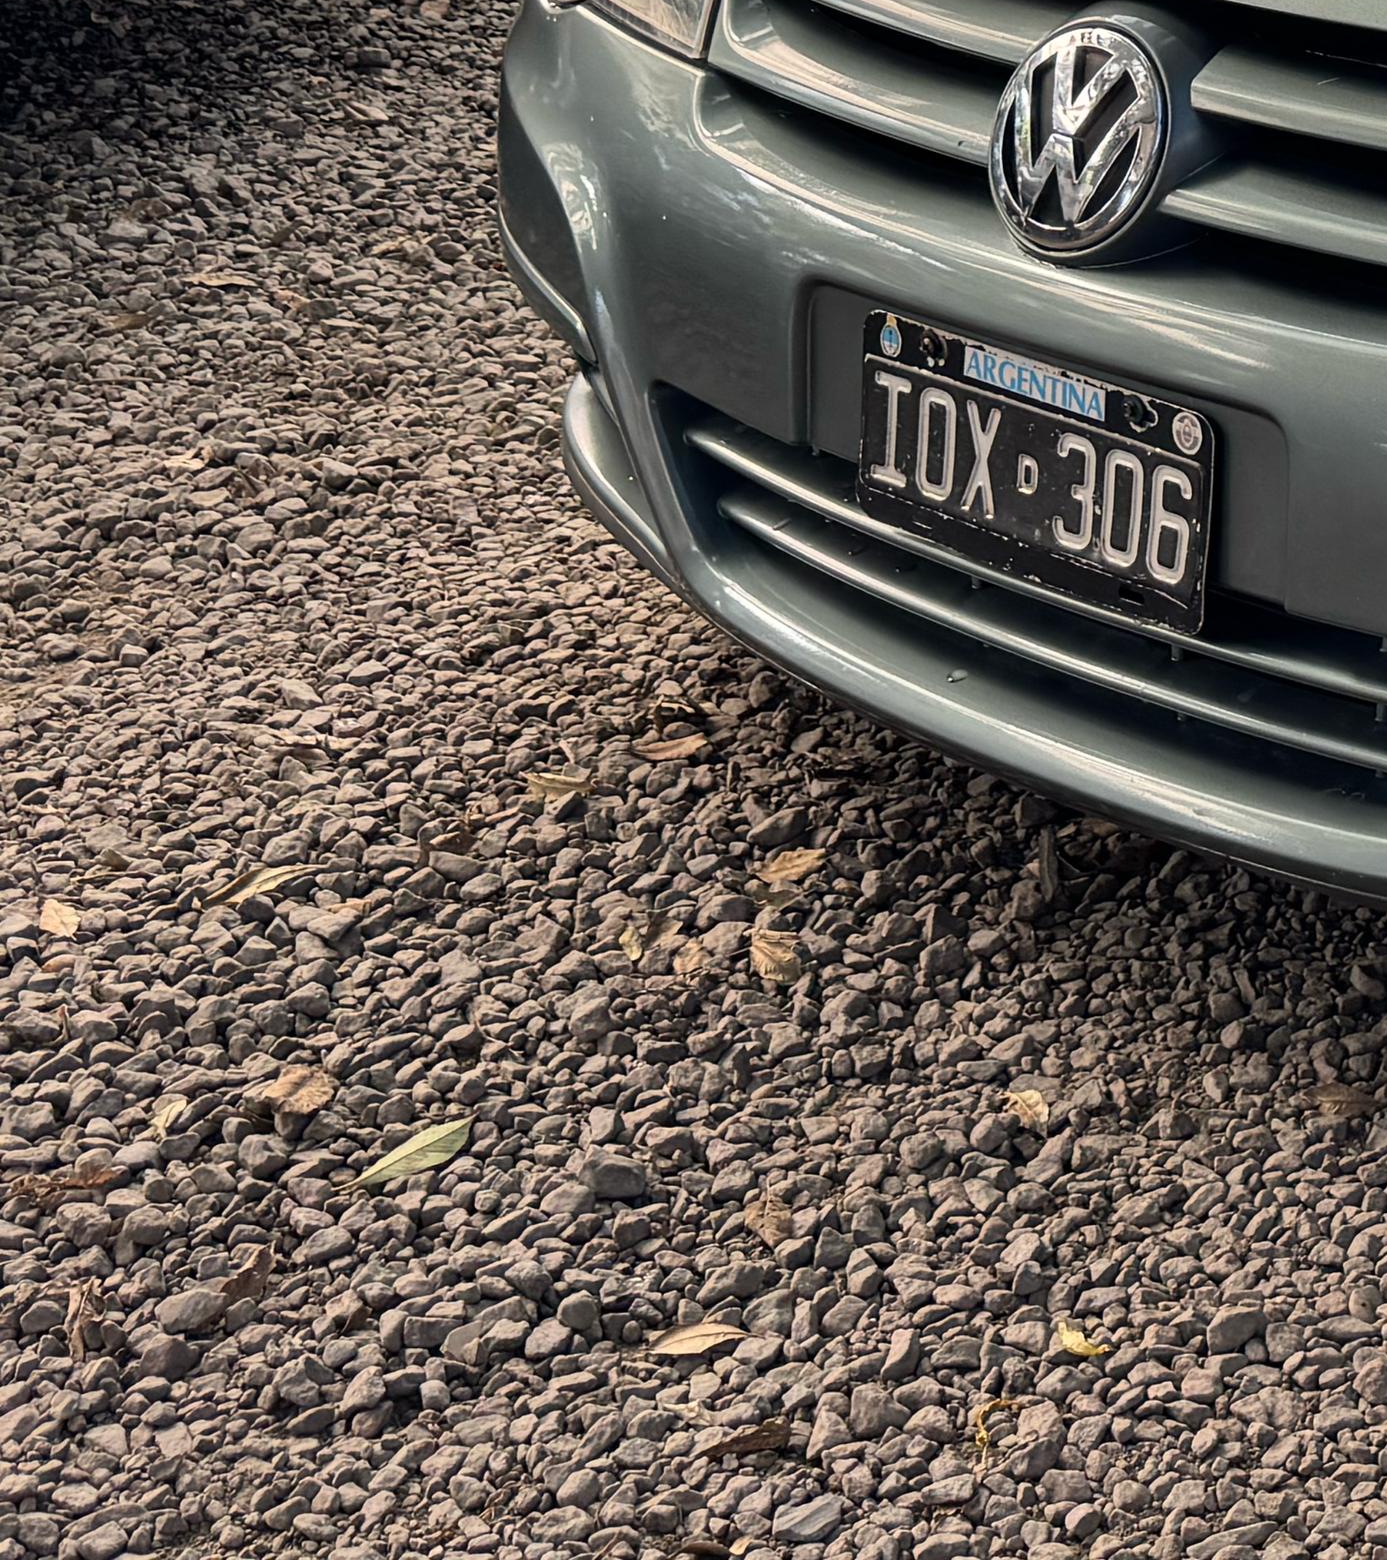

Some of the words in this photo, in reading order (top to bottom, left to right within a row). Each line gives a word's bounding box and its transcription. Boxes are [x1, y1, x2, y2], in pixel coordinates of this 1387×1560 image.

[965, 349, 1105, 421] ARGENTINA
[869, 370, 1002, 519] IOX
[1051, 431, 1193, 585] 306
